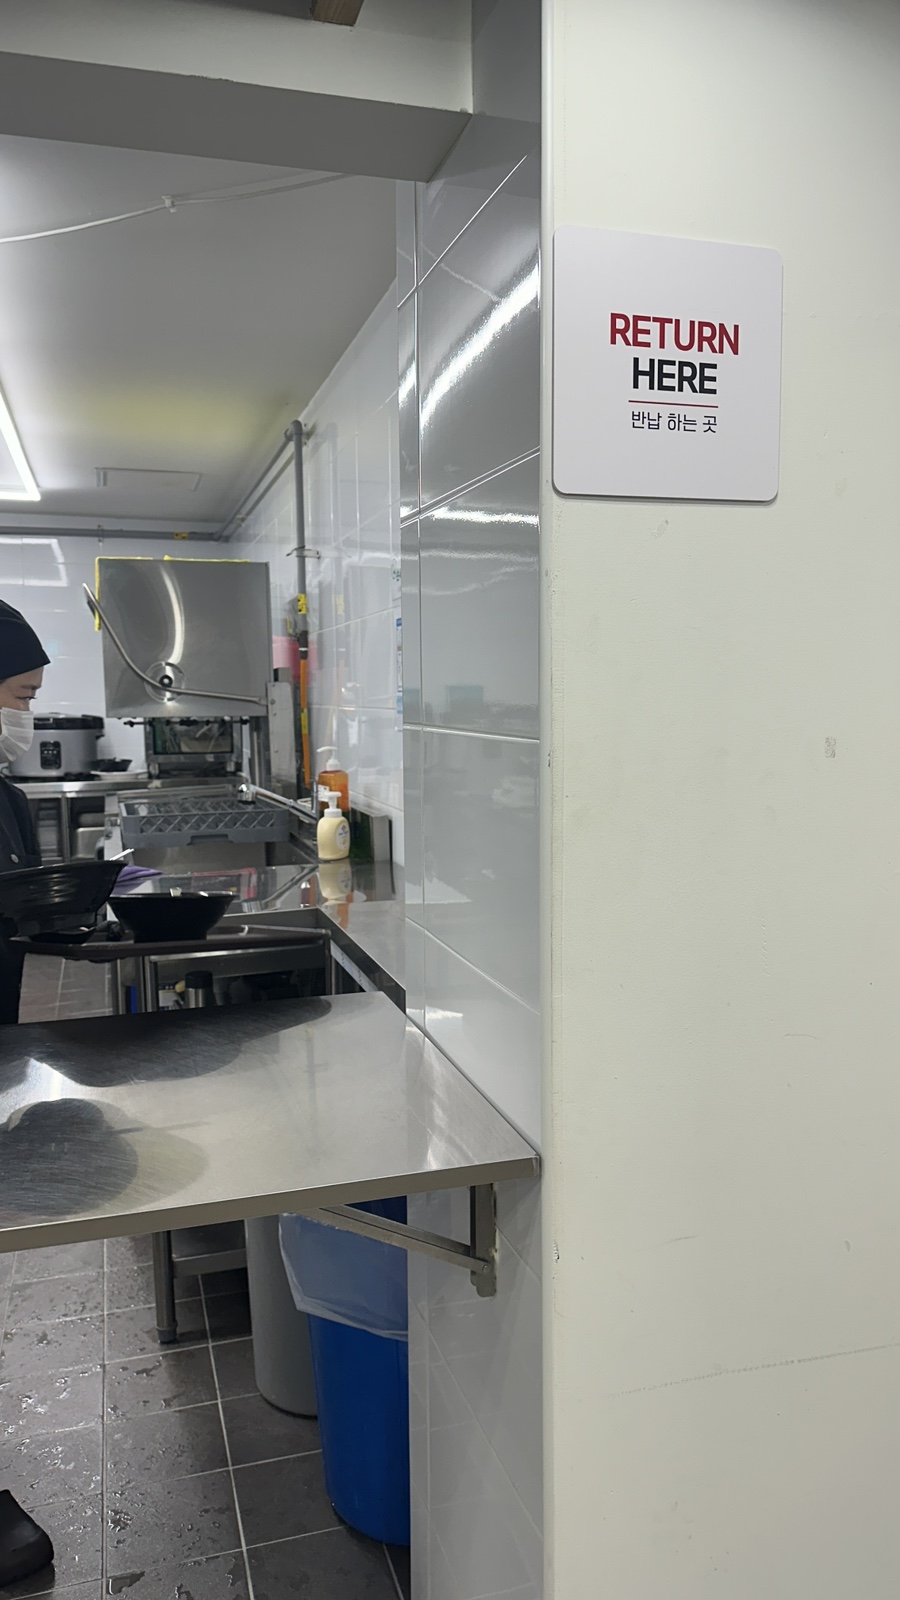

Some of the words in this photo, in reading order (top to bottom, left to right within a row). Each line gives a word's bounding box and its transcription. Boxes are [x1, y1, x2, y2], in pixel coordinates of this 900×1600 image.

[610, 312, 739, 356] RETURN
[632, 356, 718, 395] HERE
[631, 410, 662, 430] 반납
[667, 412, 698, 432] 하는
[702, 415, 718, 434] 곳
